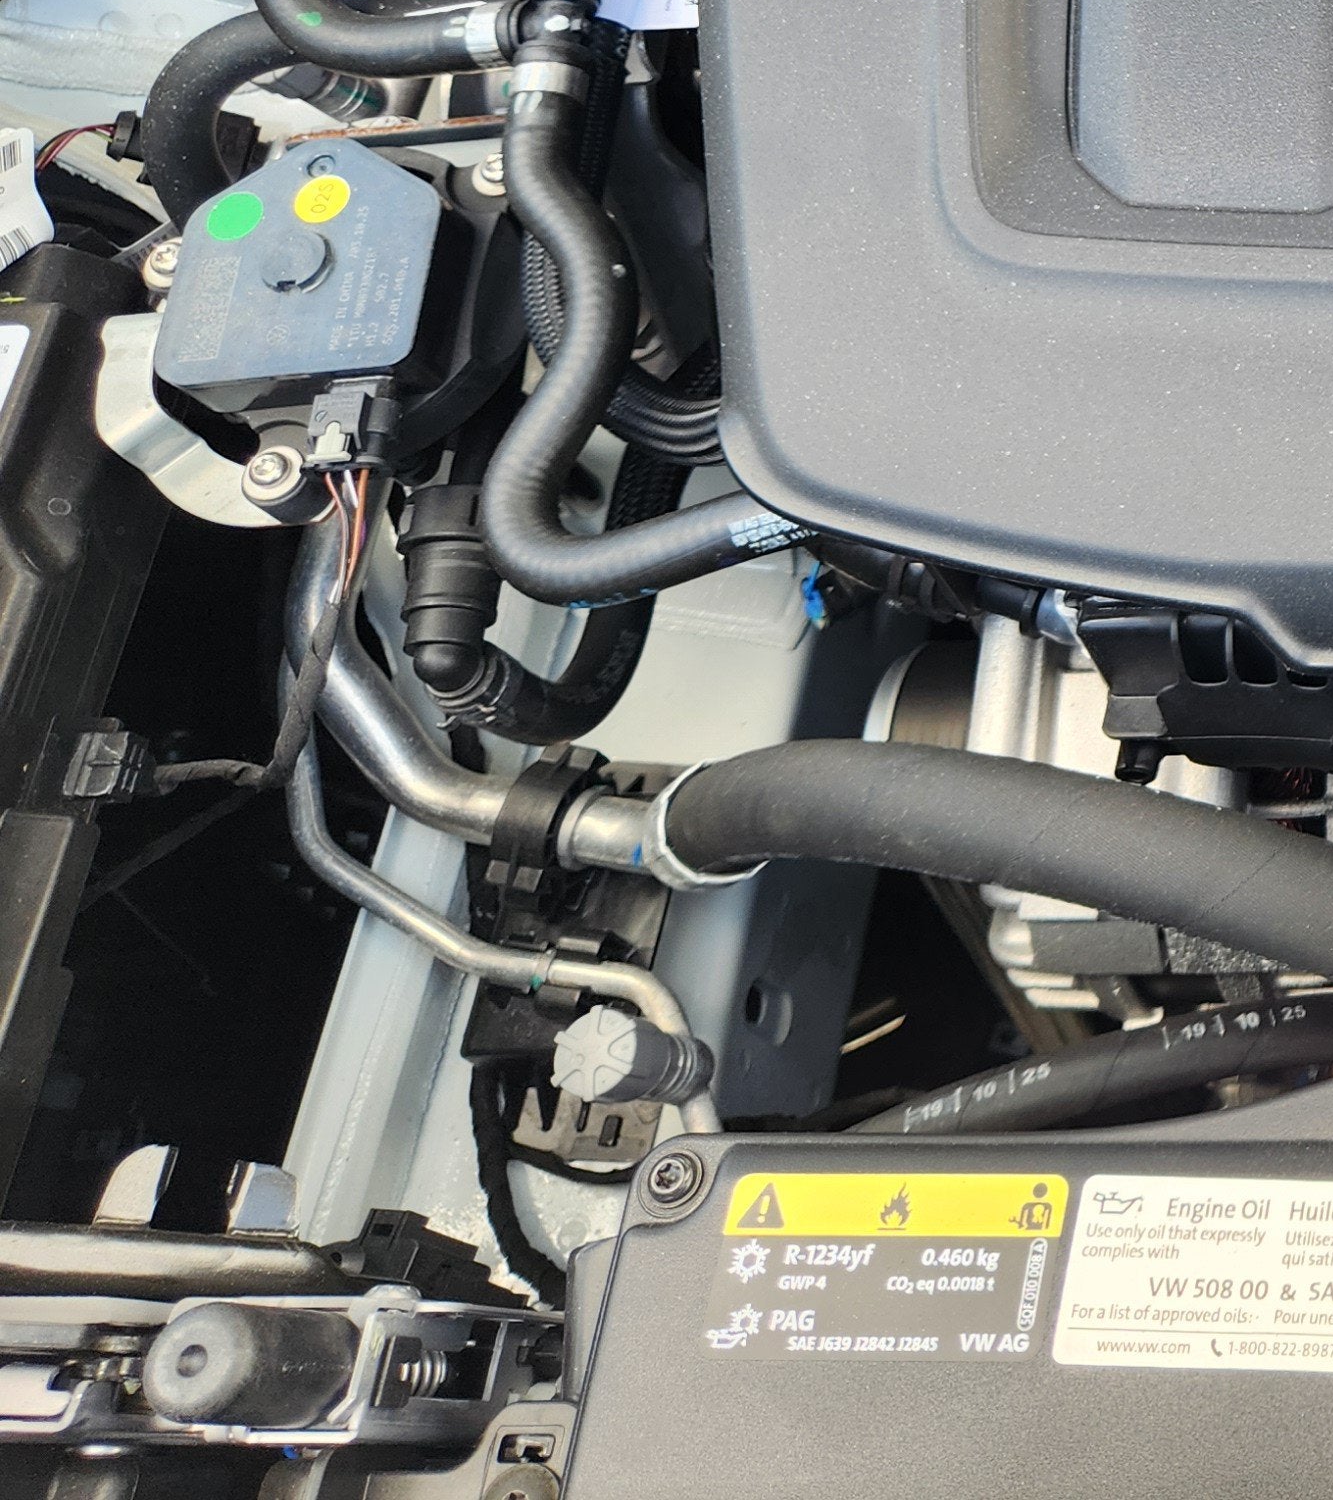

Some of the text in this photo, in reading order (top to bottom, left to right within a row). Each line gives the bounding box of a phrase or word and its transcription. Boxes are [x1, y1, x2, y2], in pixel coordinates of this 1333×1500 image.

[1166, 1197, 1270, 1223] Engine Oil
[1086, 1223, 1266, 1247] Use only oil that expressly
[783, 1243, 875, 1271] R-1234yf
[920, 1248, 999, 1271] 0.460 kg
[1081, 1242, 1179, 1259] complies with
[1281, 1250, 1305, 1266] qui
[777, 1274, 826, 1289] GWP 4
[915, 1279, 935, 1294] eq
[936, 1276, 985, 1291] 0.0018
[1149, 1276, 1188, 1297] VW
[1192, 1278, 1233, 1299] 508
[1239, 1279, 1268, 1300] 00
[1279, 1283, 1296, 1301] &
[769, 1309, 815, 1331] PAG
[1070, 1303, 1094, 1318] For
[1096, 1307, 1105, 1319] a
[1108, 1303, 1130, 1320] list
[1133, 1304, 1151, 1320] of
[1151, 1307, 1221, 1322] approved
[1273, 1309, 1306, 1324] Pour
[786, 1335, 816, 1350] SAE
[960, 1333, 1029, 1352] VW AG
[1096, 1340, 1190, 1354] www.vw.com
